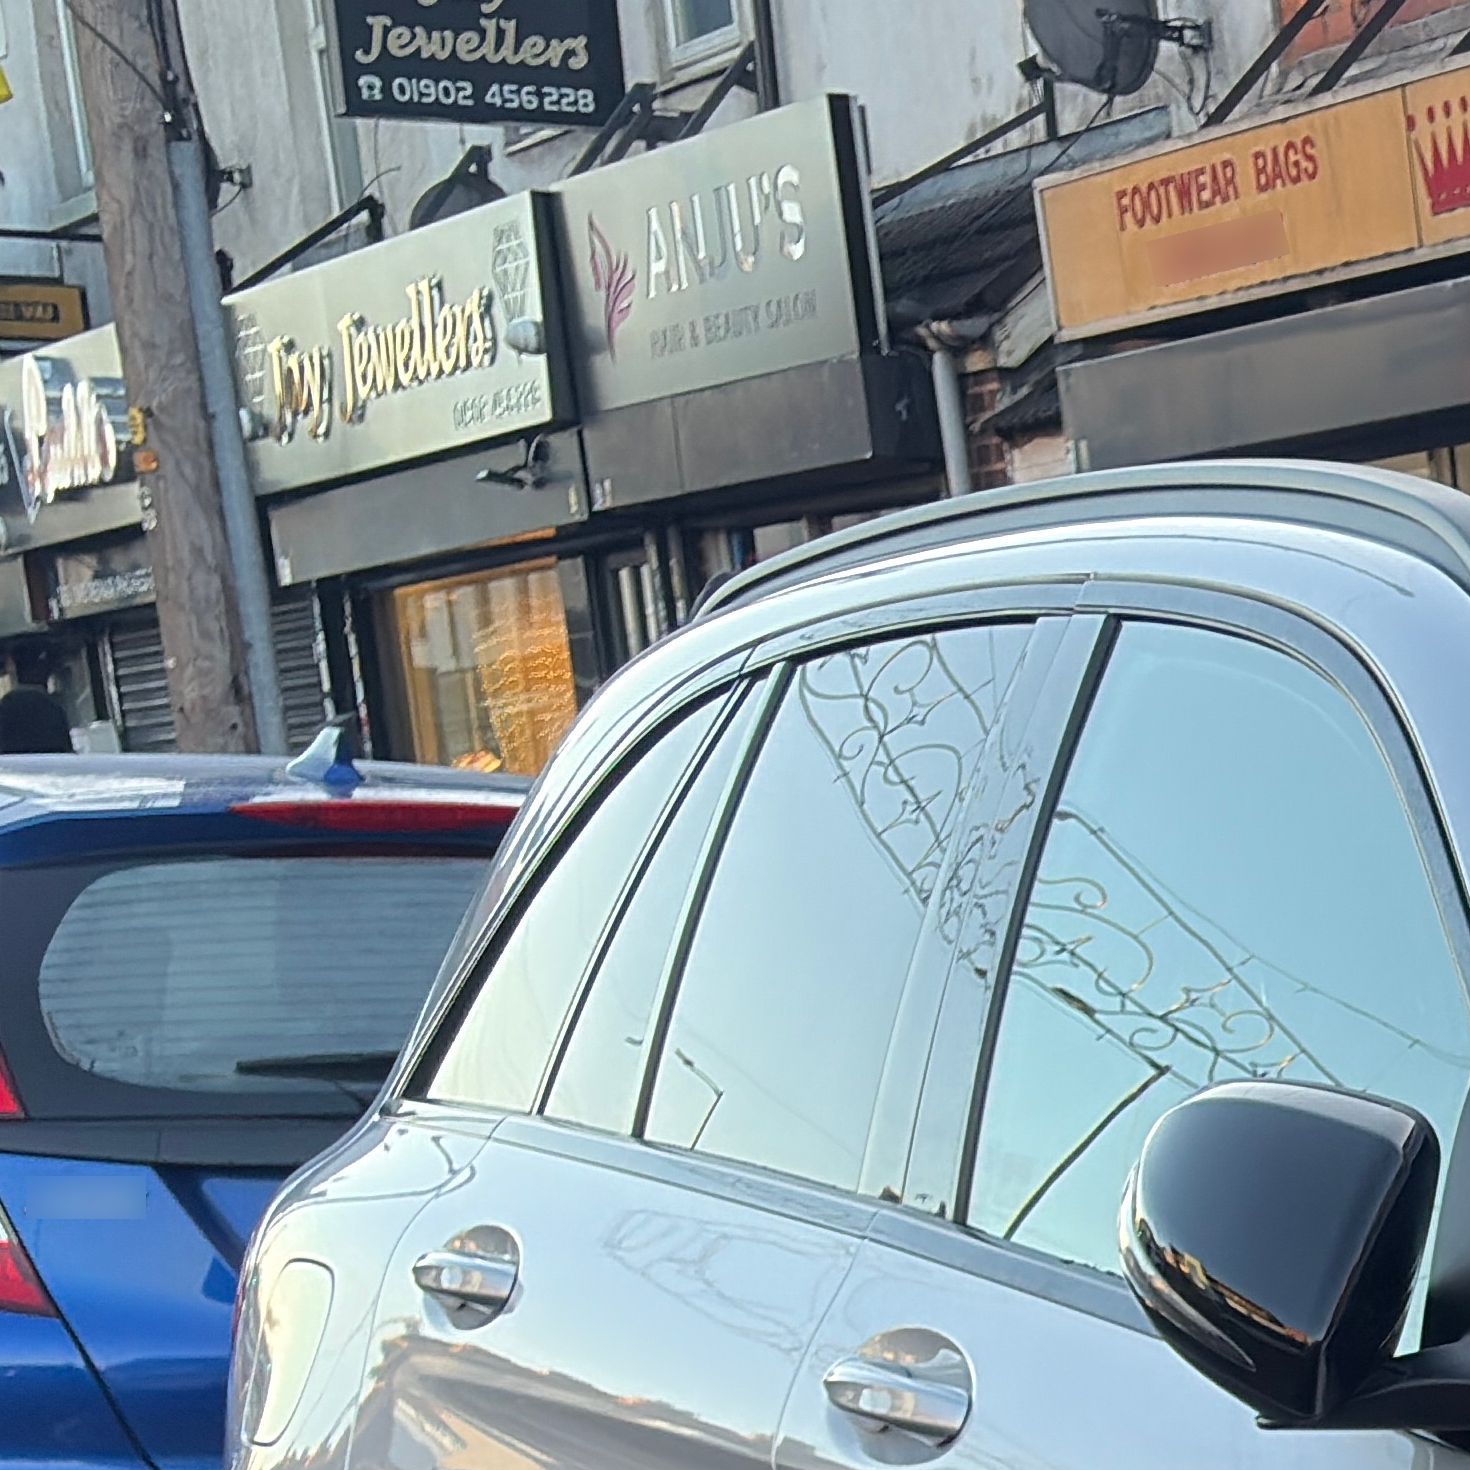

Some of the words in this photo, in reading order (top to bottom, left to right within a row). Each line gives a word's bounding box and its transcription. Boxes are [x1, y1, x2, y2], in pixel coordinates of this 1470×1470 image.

[354, 15, 589, 70] Jewellers
[392, 77, 475, 106] 01902
[647, 164, 805, 299] ANJU'S
[1115, 158, 1240, 232] FOOTWEAR
[1252, 135, 1318, 193] BAGS
[337, 272, 496, 425] Jewellers
